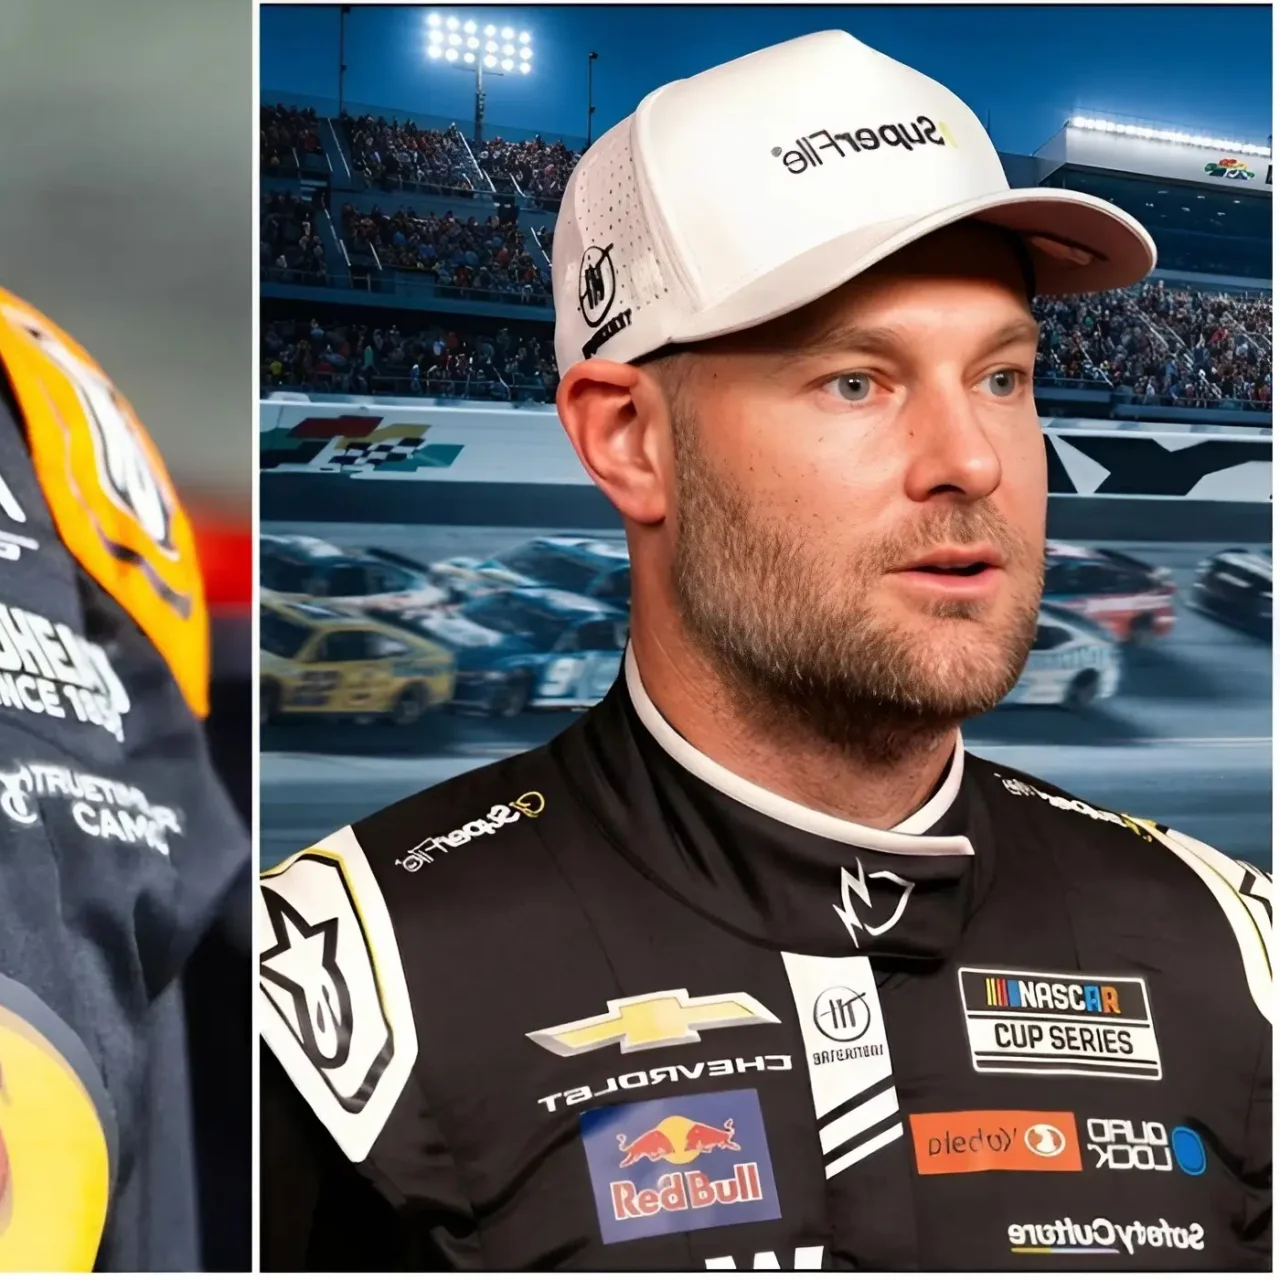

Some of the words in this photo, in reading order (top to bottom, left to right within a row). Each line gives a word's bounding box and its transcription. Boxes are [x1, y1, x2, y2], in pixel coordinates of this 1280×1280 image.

[1019, 980, 1122, 1014] NASCAR
[994, 1022, 1043, 1050] CUP
[1049, 1026, 1134, 1055] SERIES
[609, 1171, 689, 1220] Red
[686, 1161, 763, 1209] Bull
